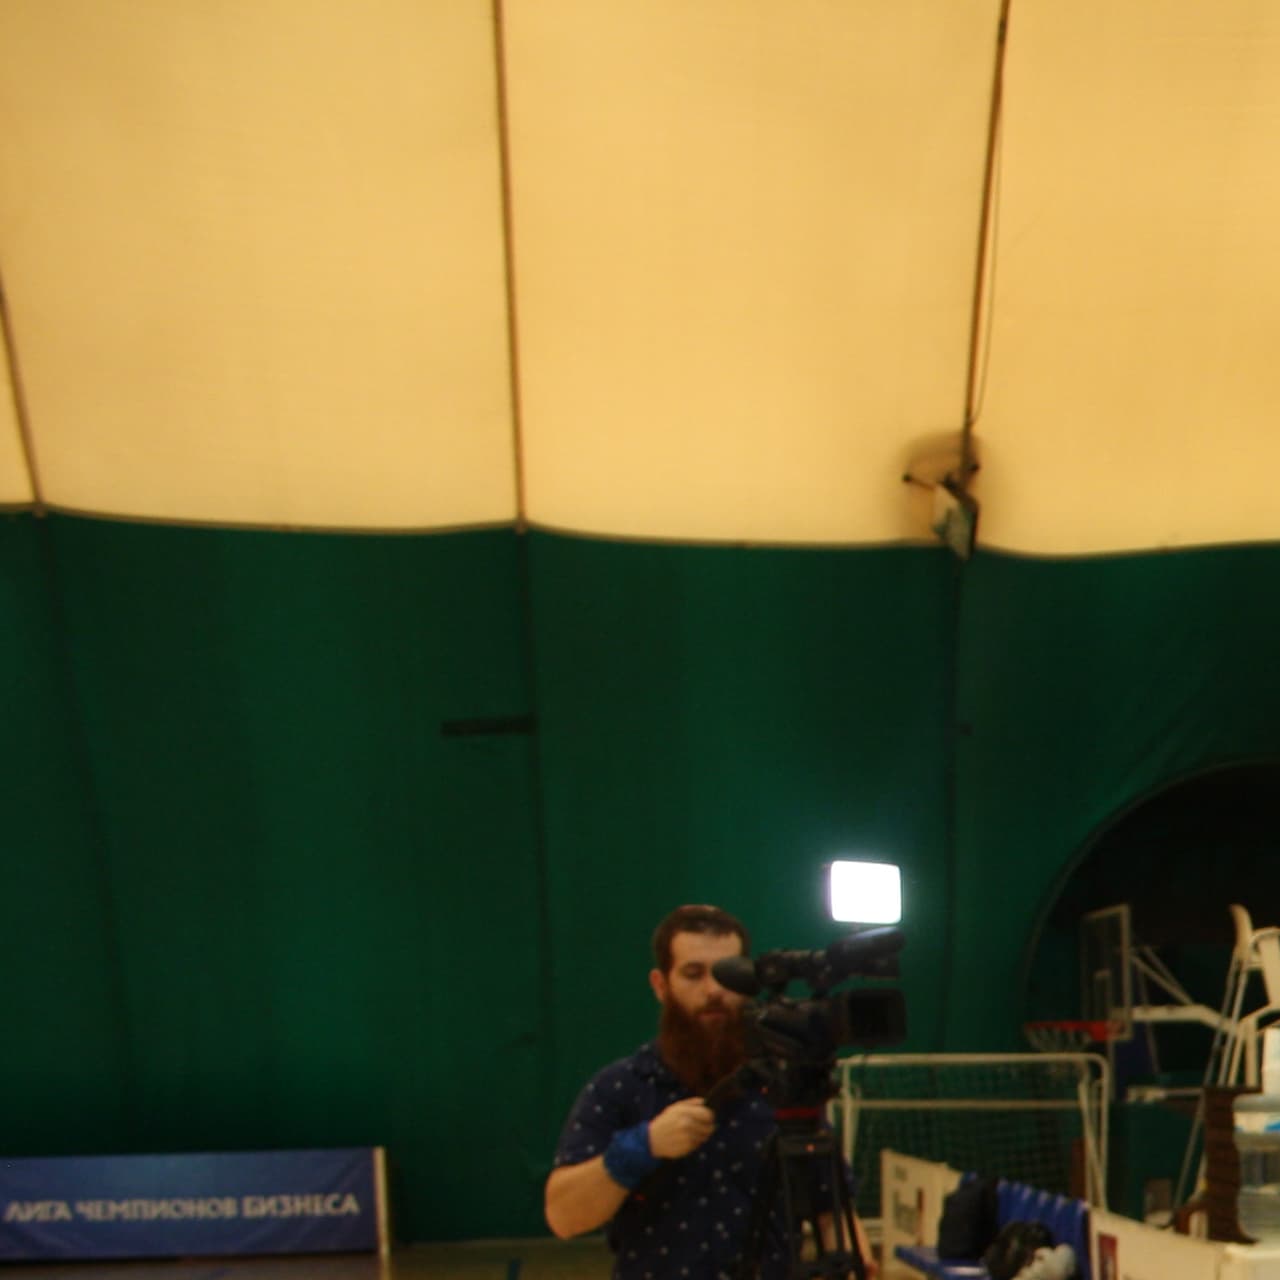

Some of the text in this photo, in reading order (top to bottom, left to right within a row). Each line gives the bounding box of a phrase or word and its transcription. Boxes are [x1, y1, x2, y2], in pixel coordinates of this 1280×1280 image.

[4, 1193, 361, 1223] ЛИГА ЧЕМПИОНОВ БИЗНЕСА
